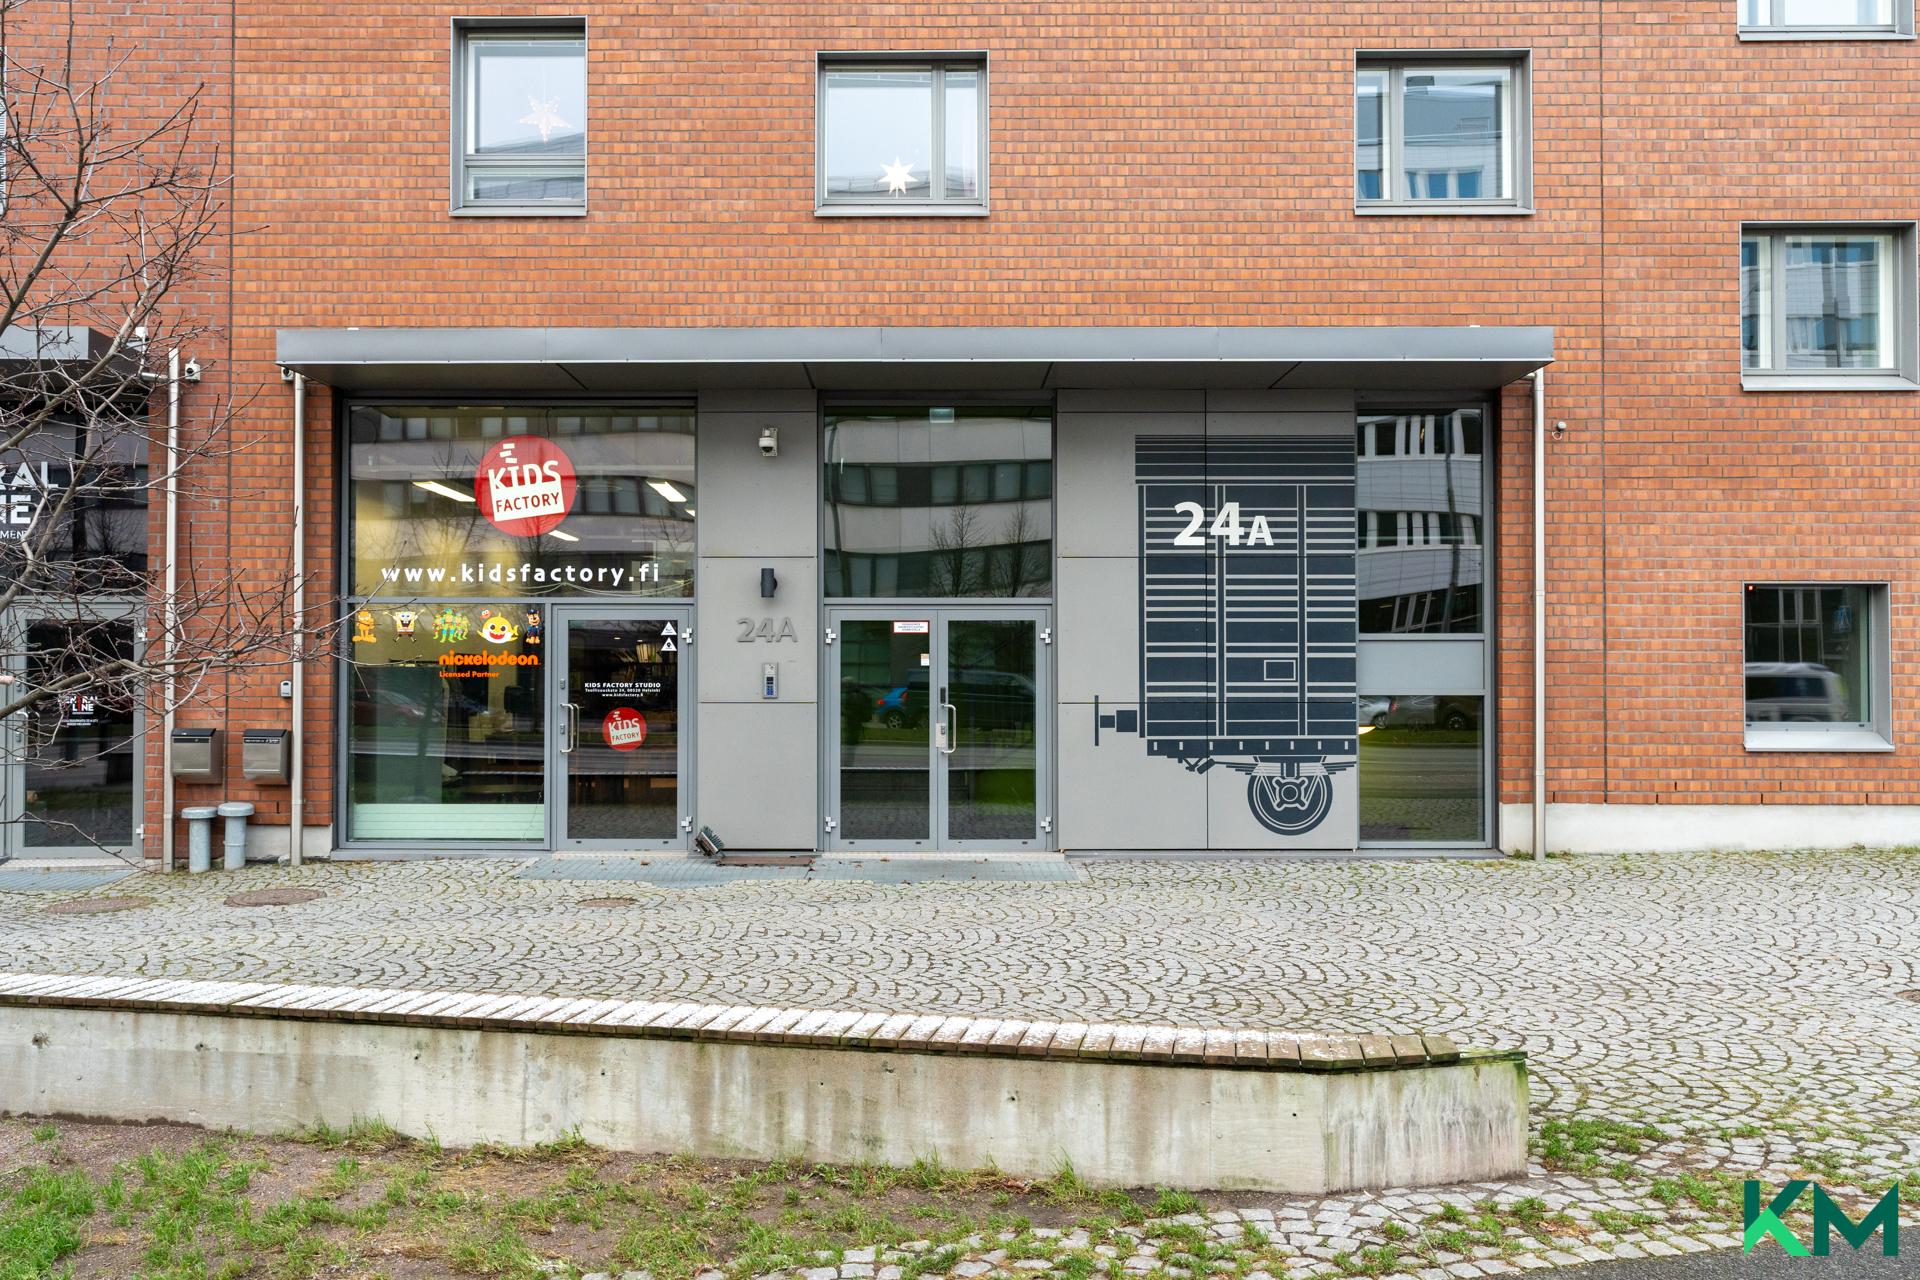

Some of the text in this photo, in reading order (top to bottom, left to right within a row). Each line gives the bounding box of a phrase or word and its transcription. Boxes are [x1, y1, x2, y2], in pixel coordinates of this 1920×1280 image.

[488, 460, 561, 489] KIDS
[495, 492, 560, 513] FACTORY
[1173, 501, 1274, 546] 24A
[381, 563, 659, 586] www.kidsfactory.fi
[736, 616, 798, 643] 24A
[439, 648, 539, 666] nickelodeon
[439, 670, 500, 678] Licensed Partner
[608, 718, 639, 731] KIDS
[611, 731, 640, 741] FACTORY
